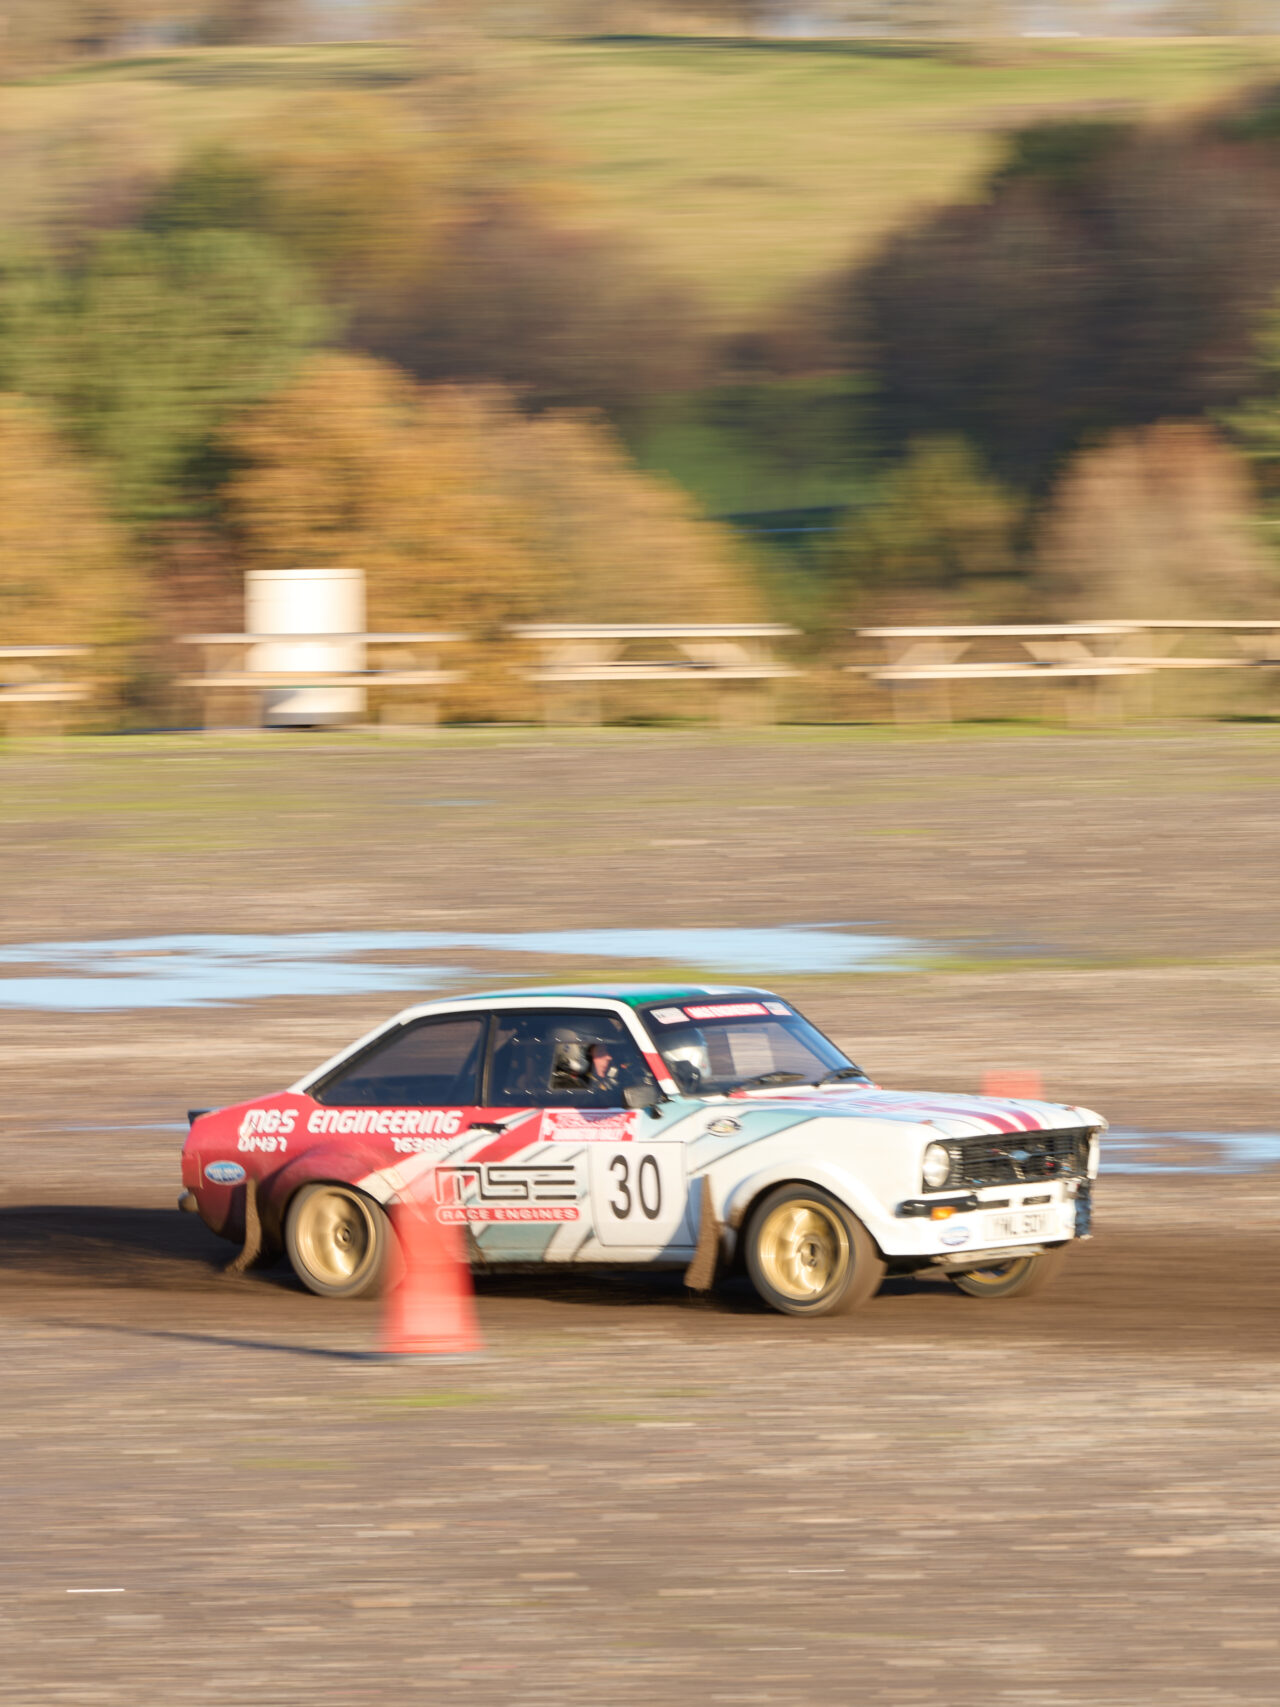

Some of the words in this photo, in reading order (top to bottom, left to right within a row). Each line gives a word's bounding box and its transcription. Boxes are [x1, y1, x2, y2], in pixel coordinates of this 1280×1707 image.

[307, 1109, 464, 1134] ENGINEERING
[609, 1154, 662, 1220] 30
[442, 1208, 490, 1220] RACE
[494, 1208, 577, 1220] ENGINES
